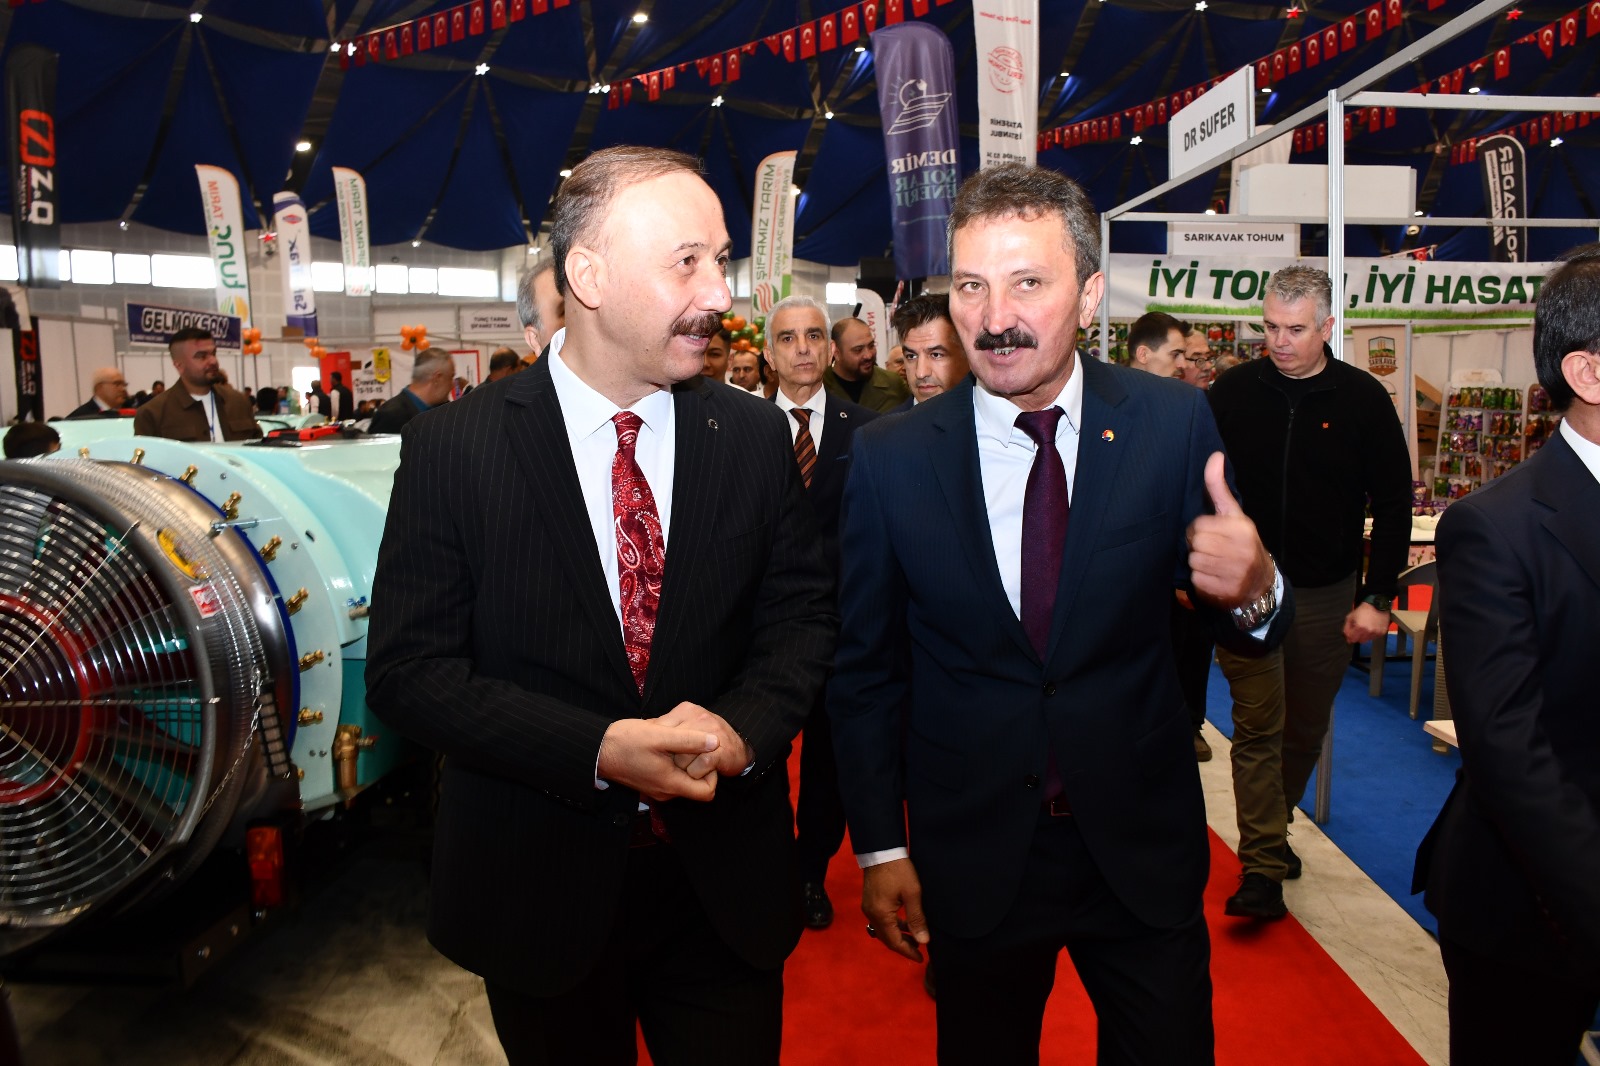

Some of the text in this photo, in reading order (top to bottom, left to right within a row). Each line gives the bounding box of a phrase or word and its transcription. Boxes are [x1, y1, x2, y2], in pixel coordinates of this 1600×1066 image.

[1184, 102, 1236, 152] DR SUFER
[760, 164, 776, 214] TARIM
[1184, 233, 1284, 242] SARIKAVAK TOHUM
[1149, 260, 1199, 298] İYİ
[1365, 265, 1416, 304] İYİ
[1424, 275, 1547, 304] HASAT
